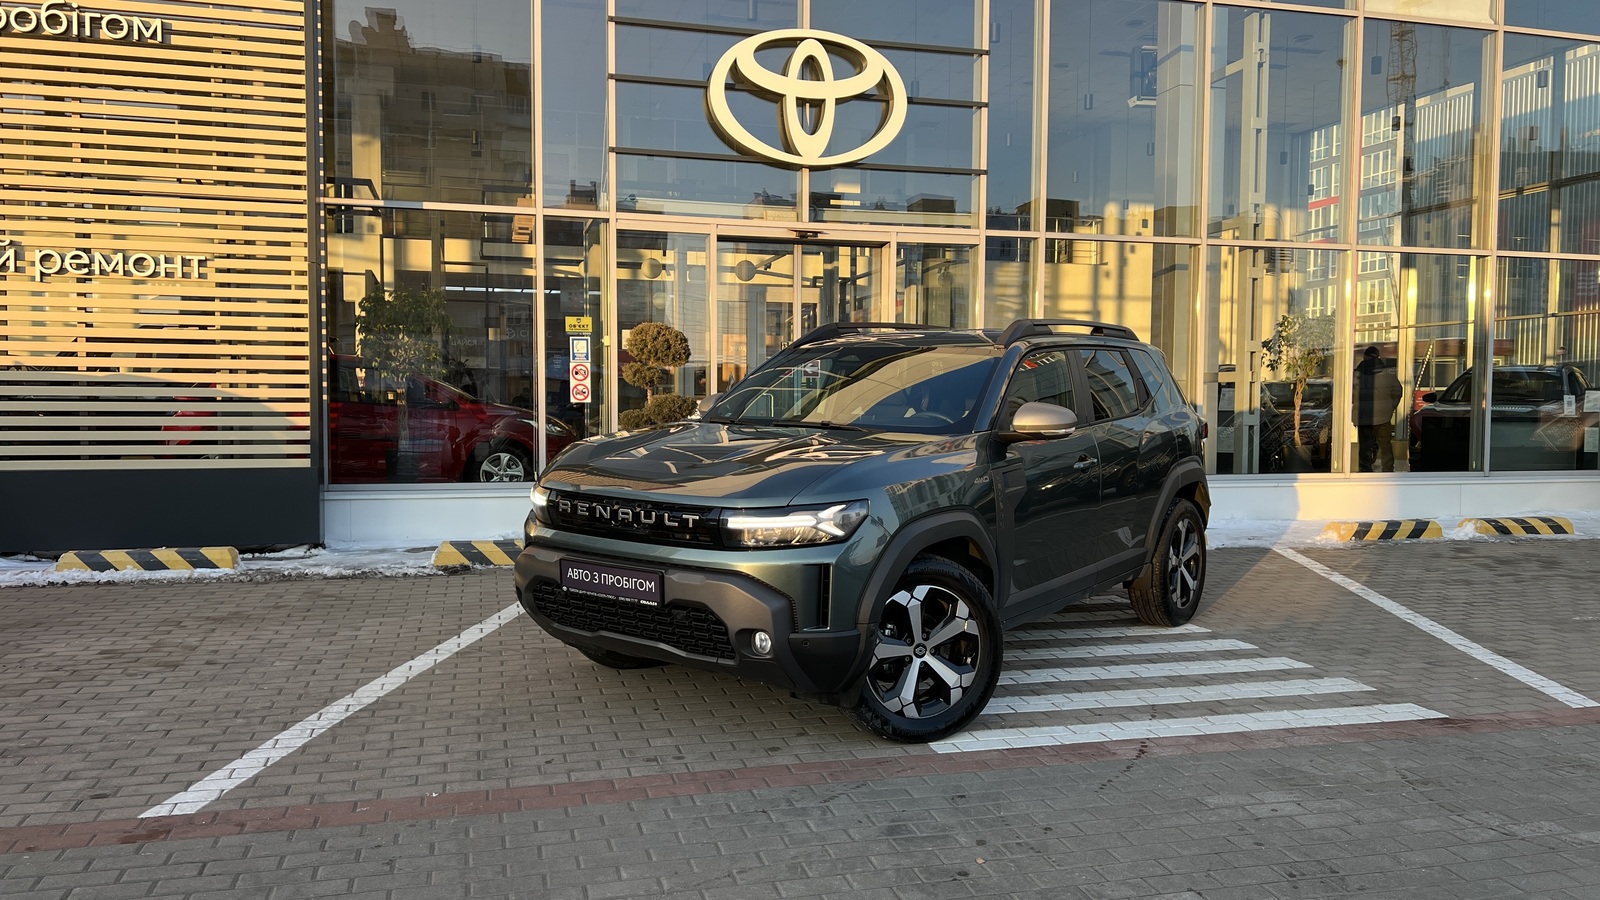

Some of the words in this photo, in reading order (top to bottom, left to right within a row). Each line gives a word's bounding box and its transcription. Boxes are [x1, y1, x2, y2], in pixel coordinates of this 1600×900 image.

[35, 249, 206, 282] ремонт
[559, 500, 699, 527] RENAULT
[567, 568, 591, 582] АВТО
[601, 573, 655, 592] ПРОБІГОМ
